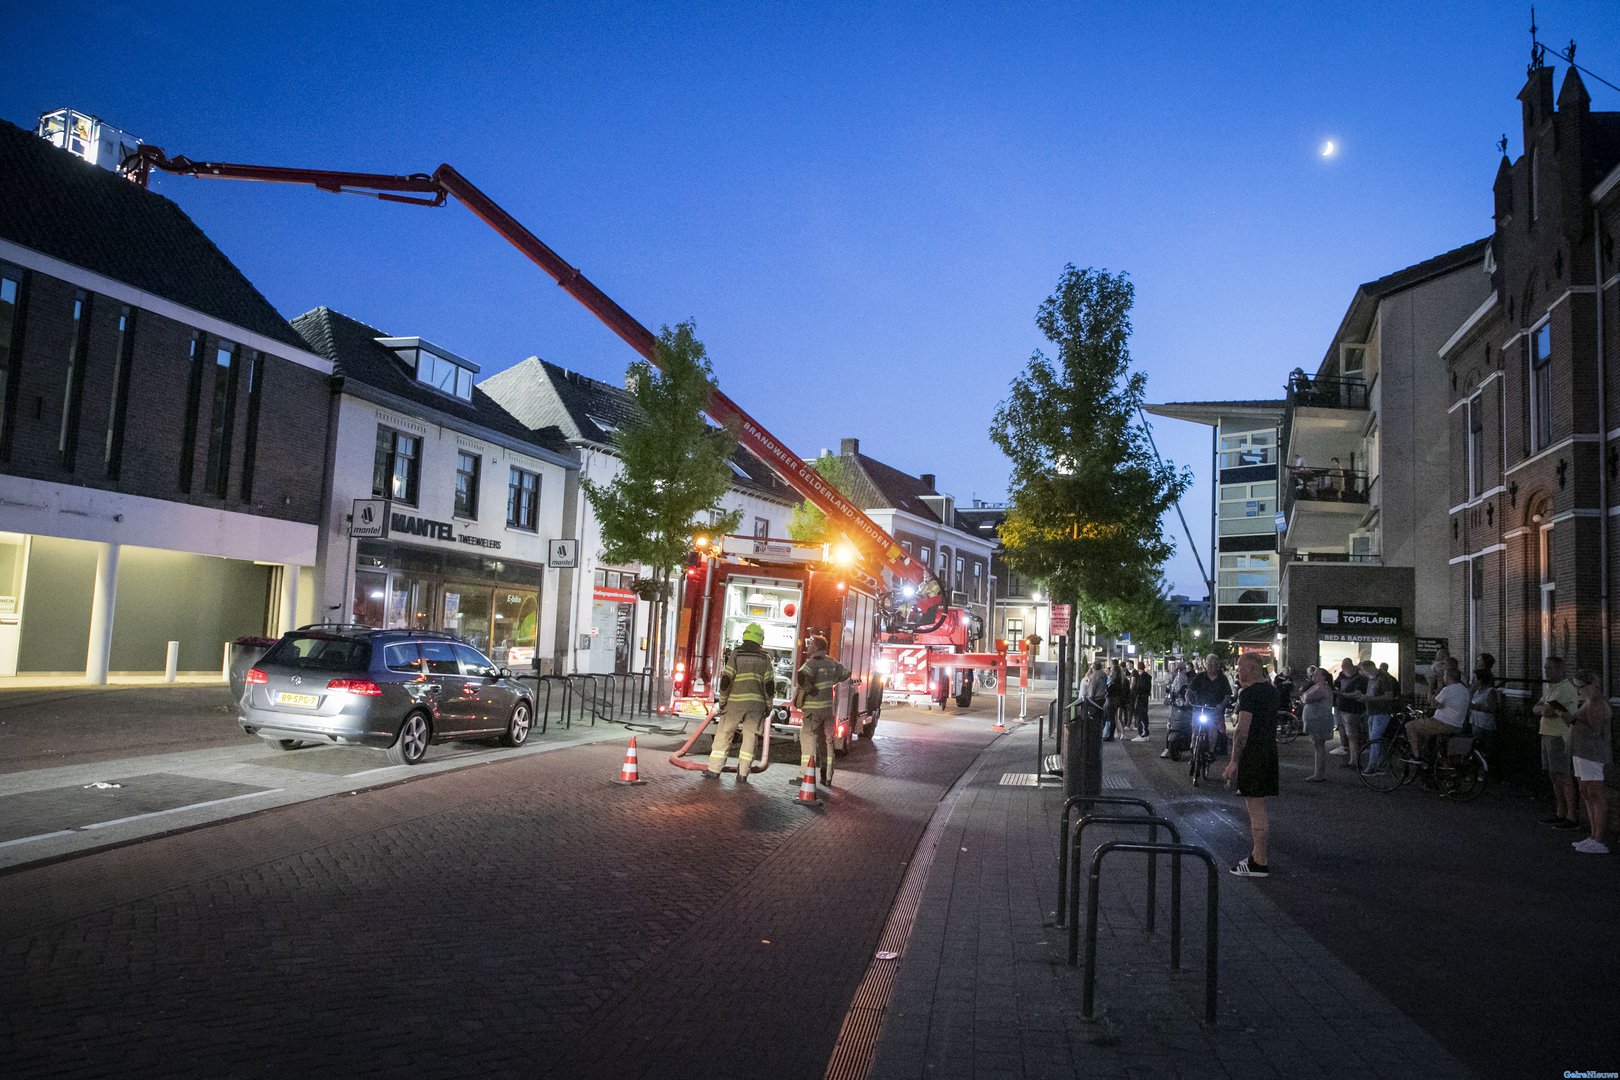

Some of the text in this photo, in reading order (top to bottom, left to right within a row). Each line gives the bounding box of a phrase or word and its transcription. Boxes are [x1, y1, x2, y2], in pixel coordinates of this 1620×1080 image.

[743, 421, 798, 471] BRANDWEER
[353, 525, 382, 534] mantel
[391, 512, 502, 549] MANTEL TWEEWIELERS
[551, 558, 574, 566] mantel
[1343, 615, 1397, 625] TOPSLAPEN
[1347, 635, 1391, 643] BADTEXTIEL
